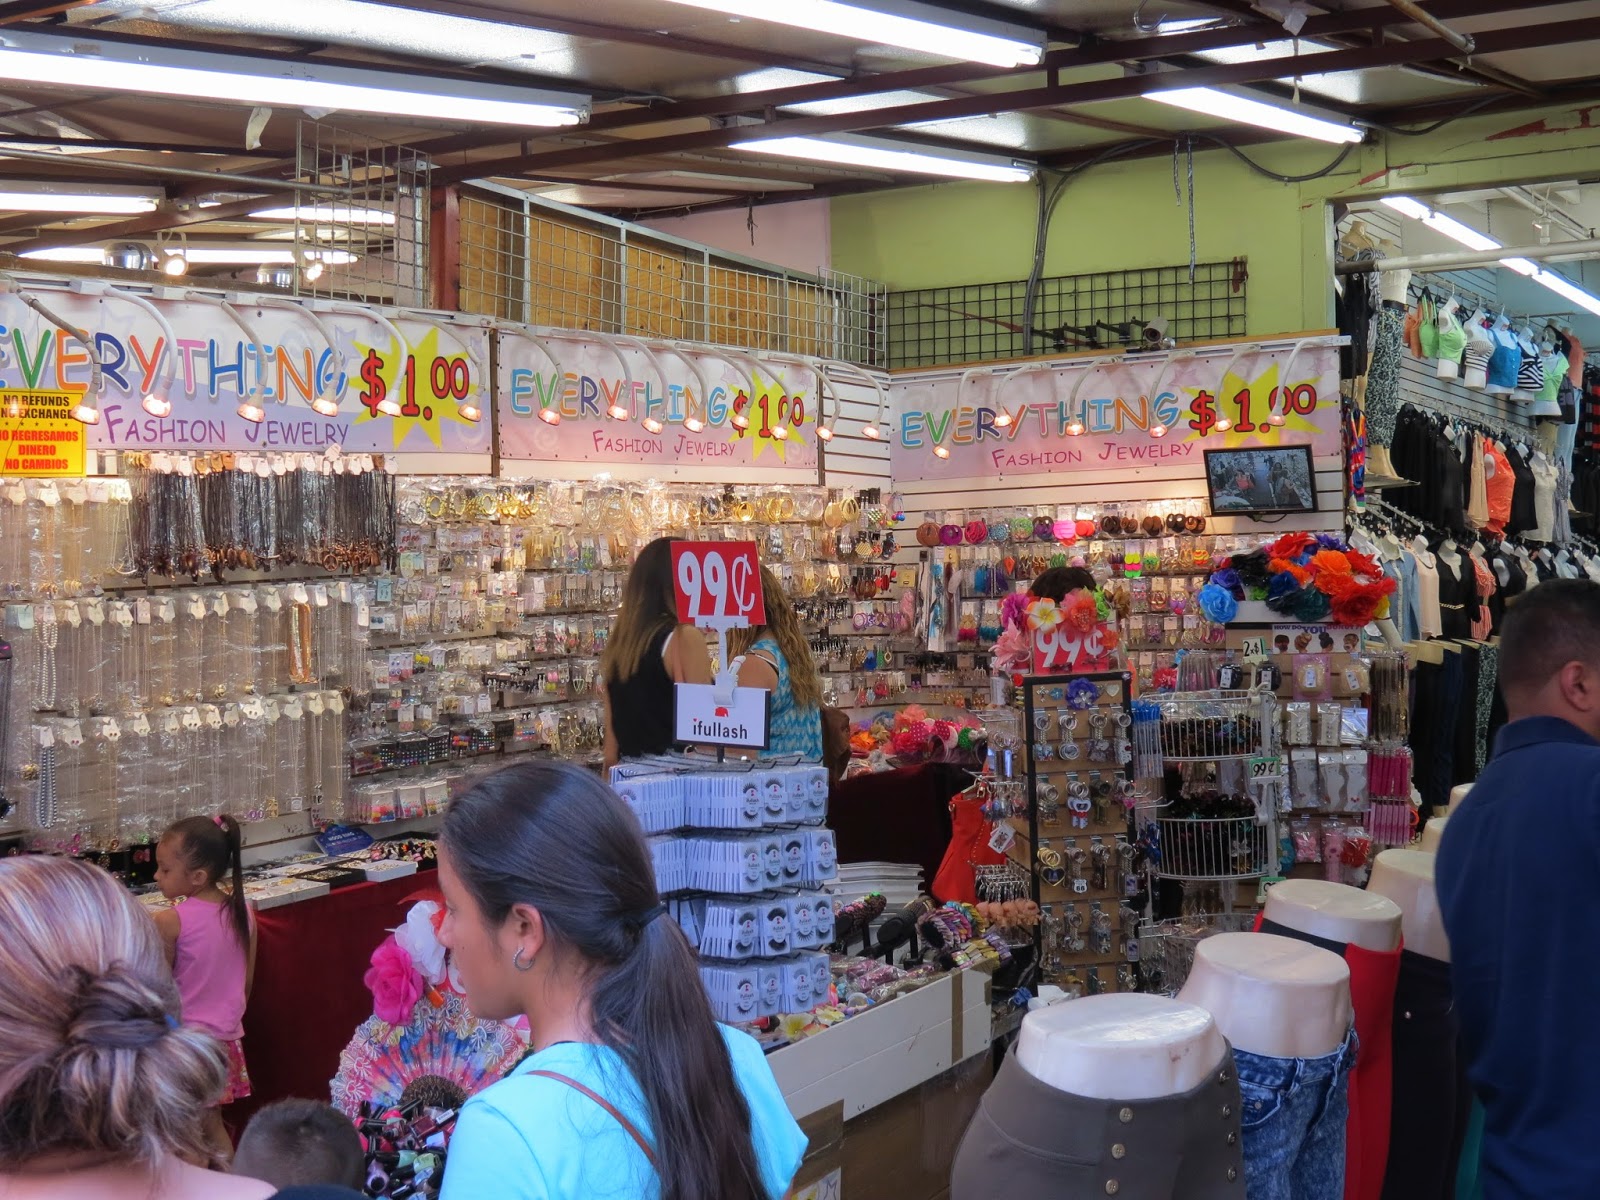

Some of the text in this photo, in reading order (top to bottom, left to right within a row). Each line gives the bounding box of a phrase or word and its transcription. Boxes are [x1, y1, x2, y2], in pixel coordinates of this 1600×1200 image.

[0, 326, 347, 403] VERYTHING
[22, 396, 70, 407] REFUNDS
[510, 368, 728, 426] EVERYTHING
[104, 405, 349, 446] FASHION JEWELRY
[901, 391, 1183, 447] EVERYTHING
[11, 430, 79, 442] REGRESAMOS
[18, 444, 56, 456] DINERO
[592, 429, 736, 457] FASHION JEWELRY
[5, 458, 69, 470] NO CAMBIOS
[992, 441, 1194, 469] FASHION JEWELRY
[693, 718, 748, 740] ifullash
